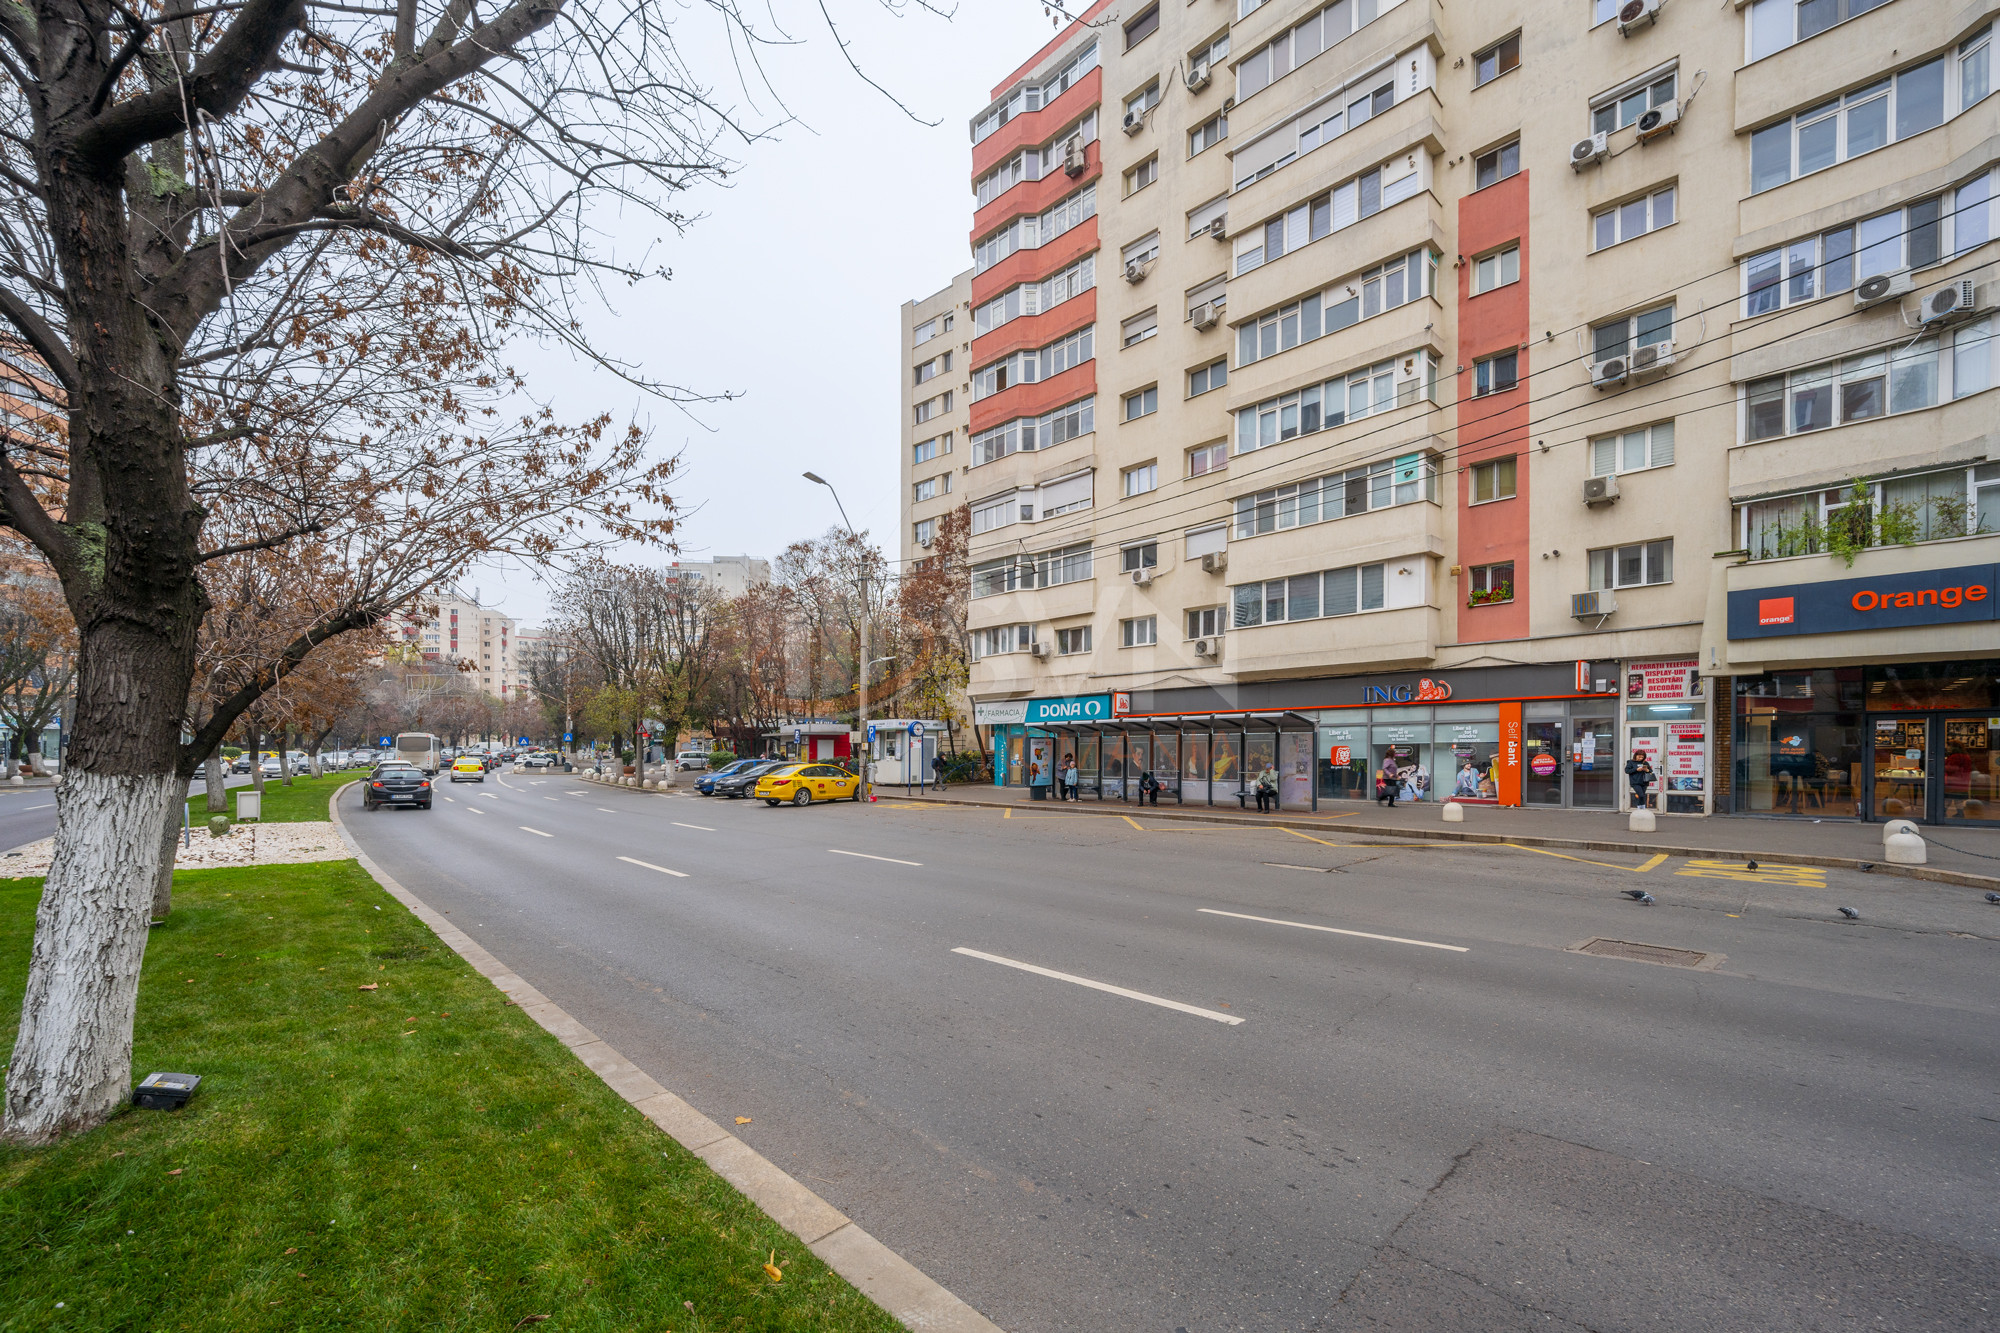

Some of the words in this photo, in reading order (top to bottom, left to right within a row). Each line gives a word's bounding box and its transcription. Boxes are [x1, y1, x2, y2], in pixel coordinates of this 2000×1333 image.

[1851, 584, 1988, 612] Orange
[1760, 615, 1790, 624] orange
[1645, 669, 1686, 677] DISPLAY-URI
[1361, 684, 1412, 703] ING
[987, 708, 1020, 717] FARMACIA
[1040, 703, 1080, 717] DONA
[869, 727, 874, 738] P
[1508, 721, 1518, 739] Self
[1508, 741, 1518, 766] Bank
